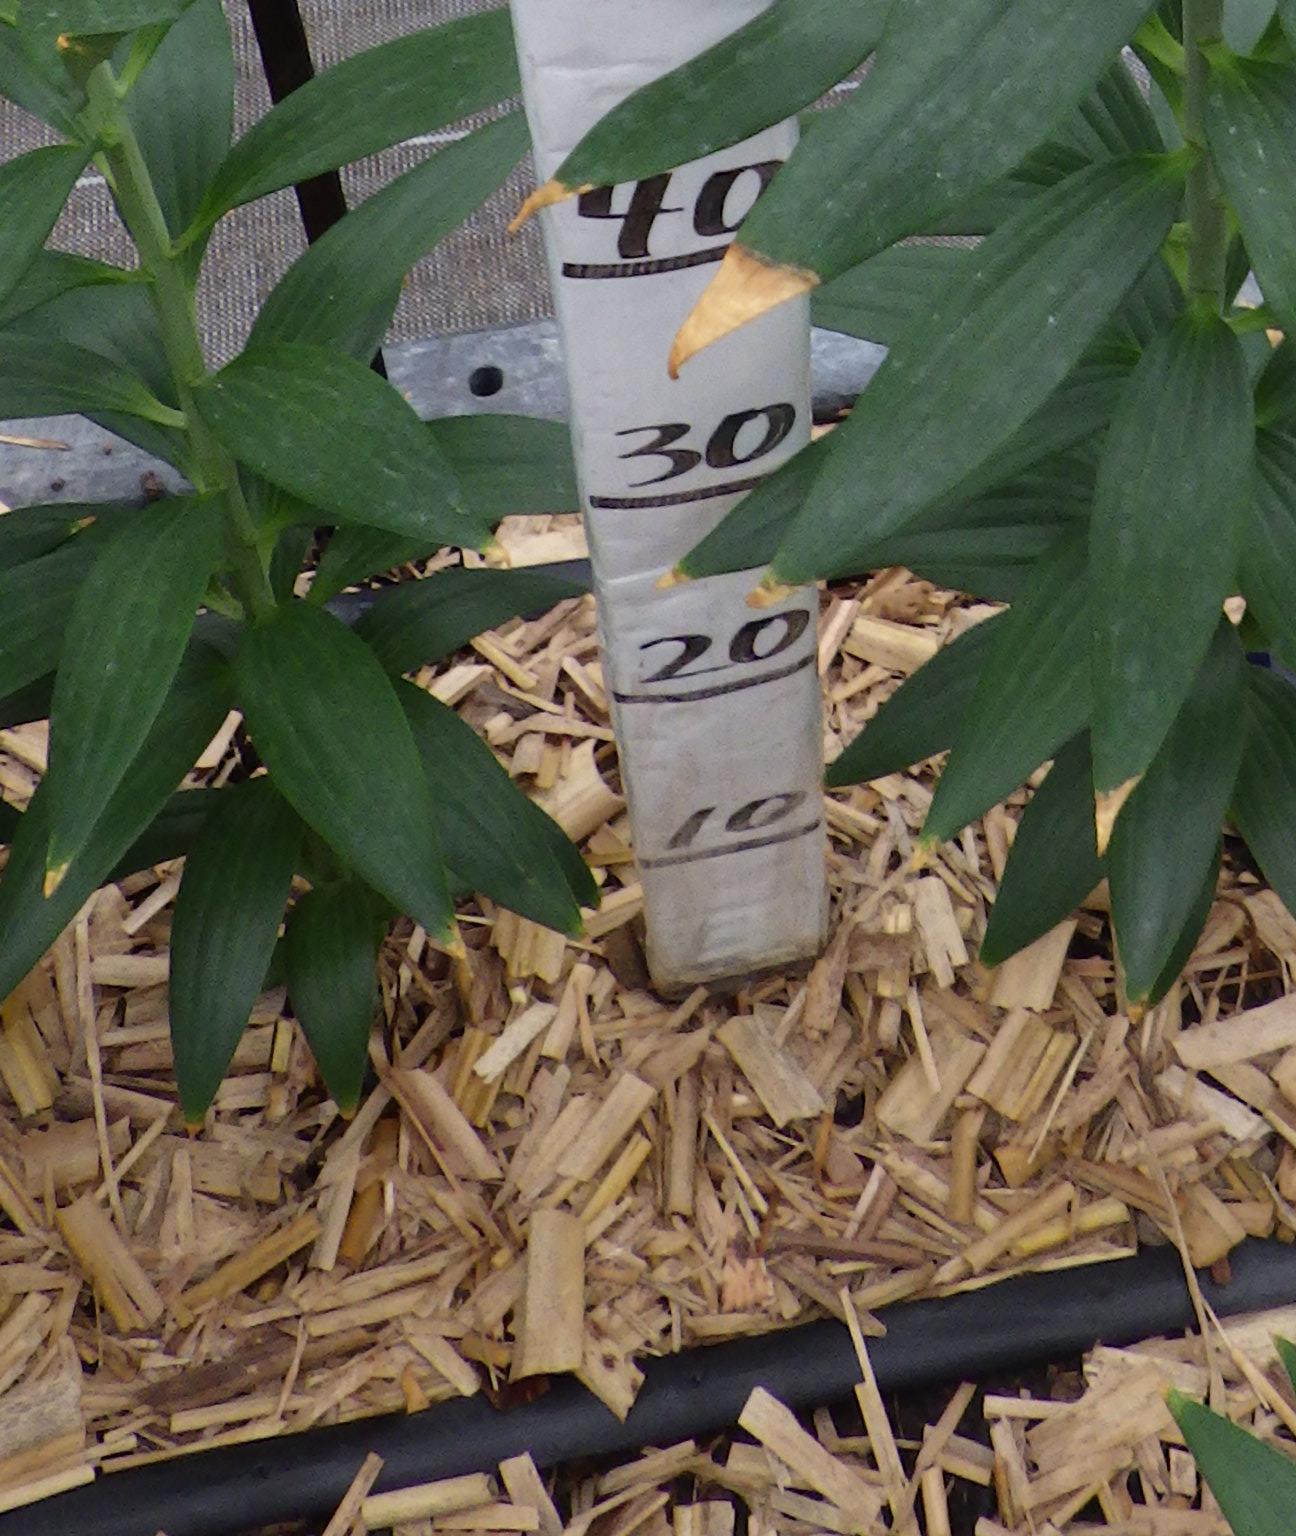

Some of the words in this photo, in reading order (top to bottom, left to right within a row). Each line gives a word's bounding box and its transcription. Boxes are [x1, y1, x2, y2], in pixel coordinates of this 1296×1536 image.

[577, 164, 783, 259] 40
[614, 402, 796, 488] 30
[639, 608, 811, 683] 20
[666, 790, 807, 851] 10
